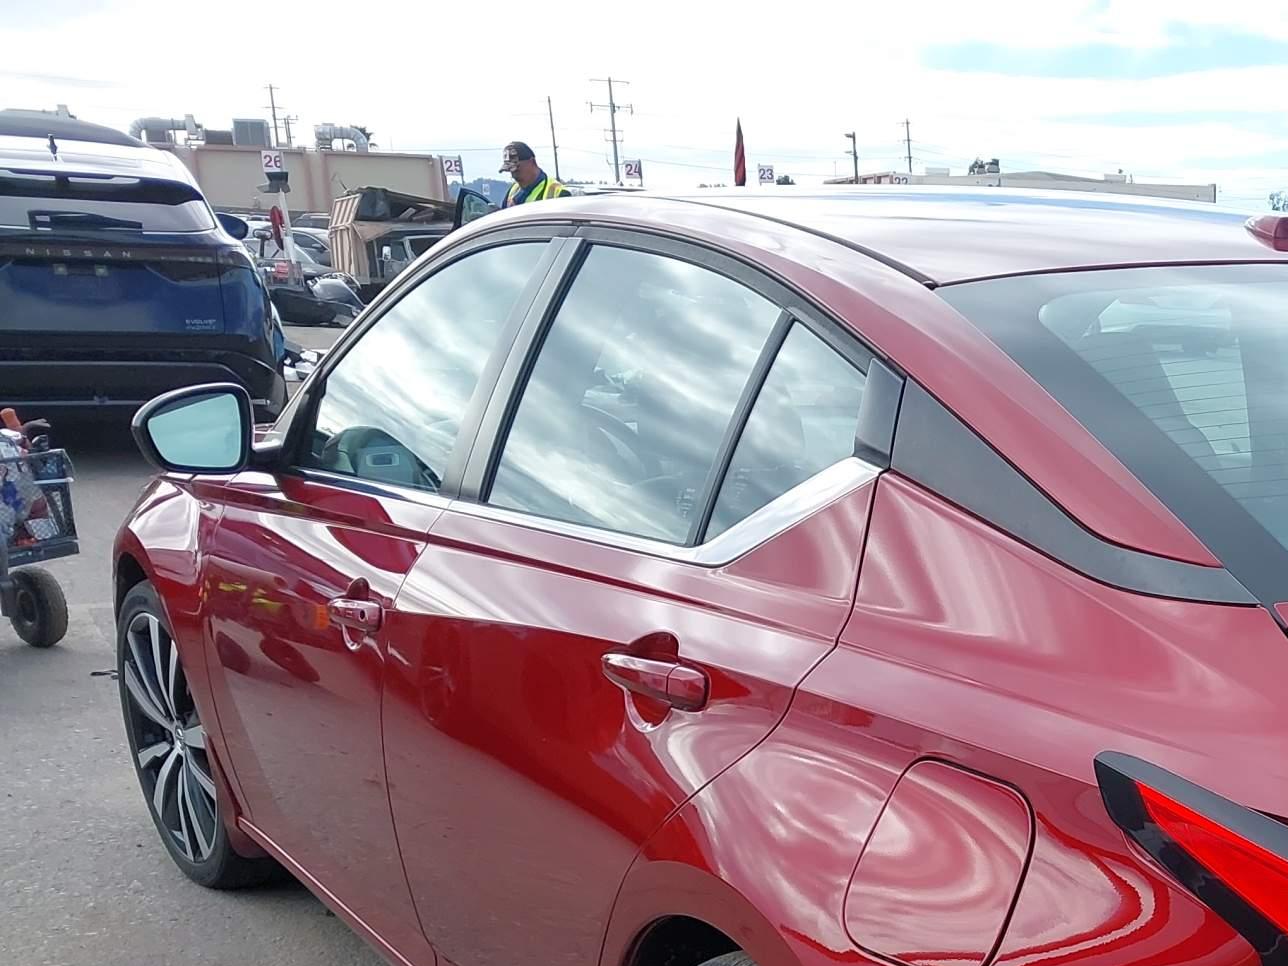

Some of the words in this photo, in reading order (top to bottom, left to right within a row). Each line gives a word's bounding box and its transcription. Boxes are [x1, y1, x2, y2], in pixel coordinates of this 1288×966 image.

[263, 154, 281, 169] 26
[444, 159, 462, 173] 25
[625, 162, 641, 177] 24
[759, 168, 774, 180] 23
[25, 248, 131, 258] NISSAN
